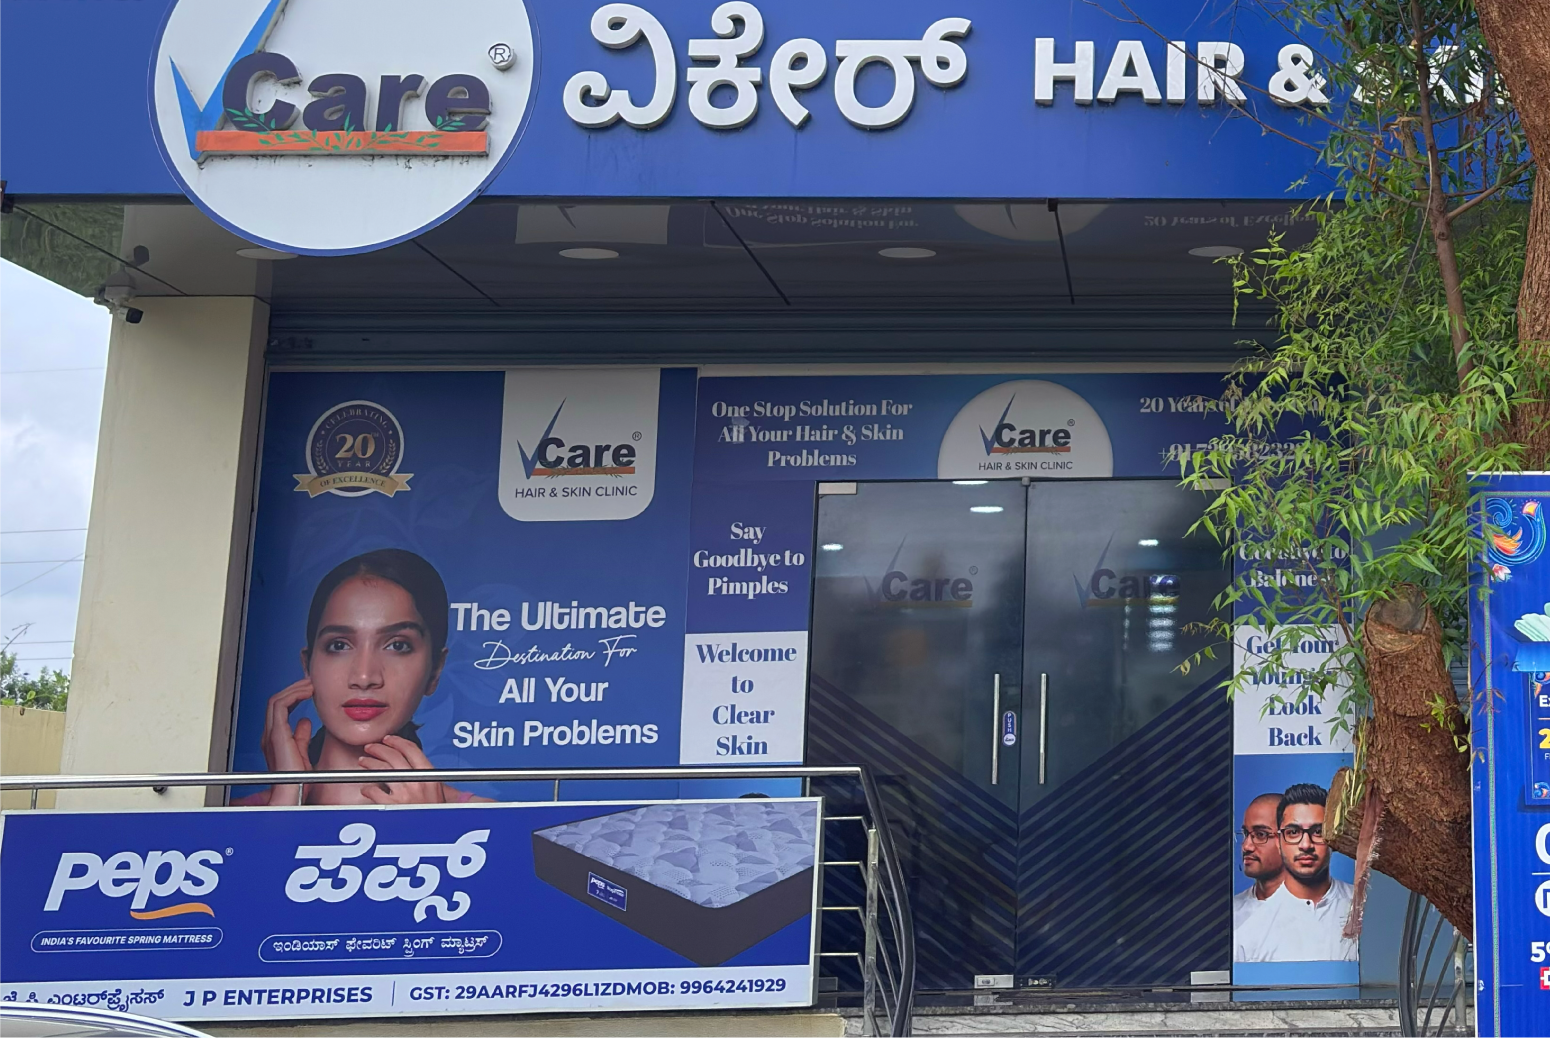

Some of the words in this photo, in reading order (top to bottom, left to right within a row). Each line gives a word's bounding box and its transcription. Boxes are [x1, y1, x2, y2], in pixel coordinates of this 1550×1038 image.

[563, 1, 972, 130] ವಿಕೇರ್
[1034, 37, 1247, 106] HAIR
[1268, 43, 1329, 107] &
[711, 401, 750, 418] One
[753, 400, 797, 422] Stop
[799, 398, 877, 417] Solution
[881, 399, 913, 416] For
[1140, 397, 1164, 413] 20
[325, 408, 388, 429] CELEBRATING
[718, 425, 745, 443] All
[749, 425, 793, 442] Your
[795, 423, 839, 442] Hair
[841, 425, 857, 446] &
[861, 423, 904, 441] Skin
[767, 448, 858, 468] Problems
[978, 462, 1003, 471] HAIR
[1005, 462, 1013, 471] &
[1014, 462, 1038, 471] SKIN
[1040, 461, 1073, 470] CLINIC
[332, 475, 386, 487] EXCELLENCE
[515, 487, 547, 499] HAIR
[549, 487, 559, 498] &
[562, 487, 592, 498] SKIN
[595, 485, 638, 498] CLINIC
[730, 521, 767, 545] Say
[693, 548, 781, 572] Goodbye
[784, 549, 806, 566] to
[707, 575, 789, 600] Pimples
[450, 602, 511, 632] The
[521, 601, 667, 632] Ultimate
[473, 640, 597, 670] Destination
[598, 634, 638, 667] For
[695, 642, 798, 664] Welcome
[499, 677, 536, 704] All
[544, 677, 610, 703] Your
[731, 675, 755, 695] to
[712, 704, 776, 726] Clear
[1268, 694, 1322, 716] Look
[452, 721, 515, 749] Skin
[523, 719, 659, 747] Problems
[1268, 725, 1322, 747] Back
[716, 735, 769, 757] Skin
[285, 822, 491, 924] ಪೆಪ್ಸ್
[40, 936, 74, 946] INDIA'S
[75, 935, 126, 946] FAVOURITE
[128, 935, 161, 945] SPRING
[163, 934, 213, 944] MATTRESS
[183, 990, 195, 1007] J
[203, 989, 217, 1006] P
[223, 986, 373, 1006] ENTERPRISES
[410, 986, 450, 1001] GST:
[680, 978, 787, 995] 9964241929
